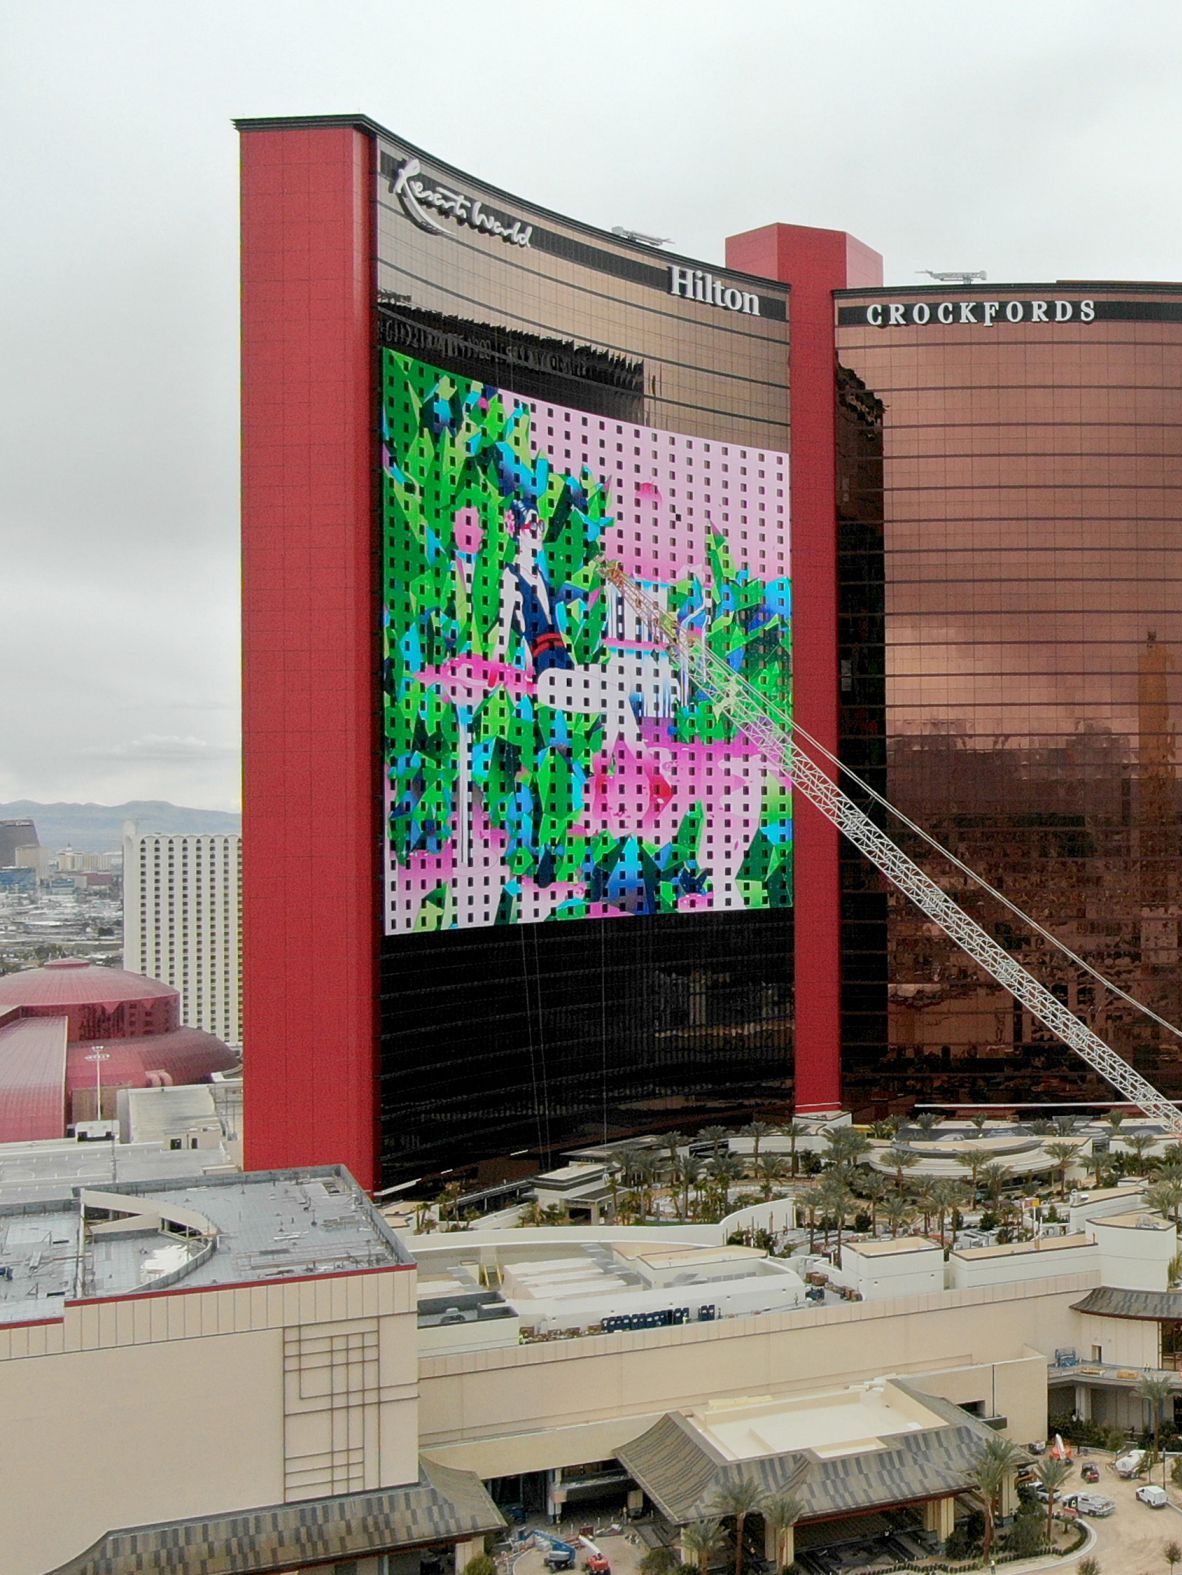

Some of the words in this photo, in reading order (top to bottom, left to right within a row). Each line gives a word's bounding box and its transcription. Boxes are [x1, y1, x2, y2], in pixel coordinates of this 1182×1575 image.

[471, 201, 532, 248] World
[670, 264, 761, 316] Hilton
[866, 299, 1096, 327] CROCKFORDS
